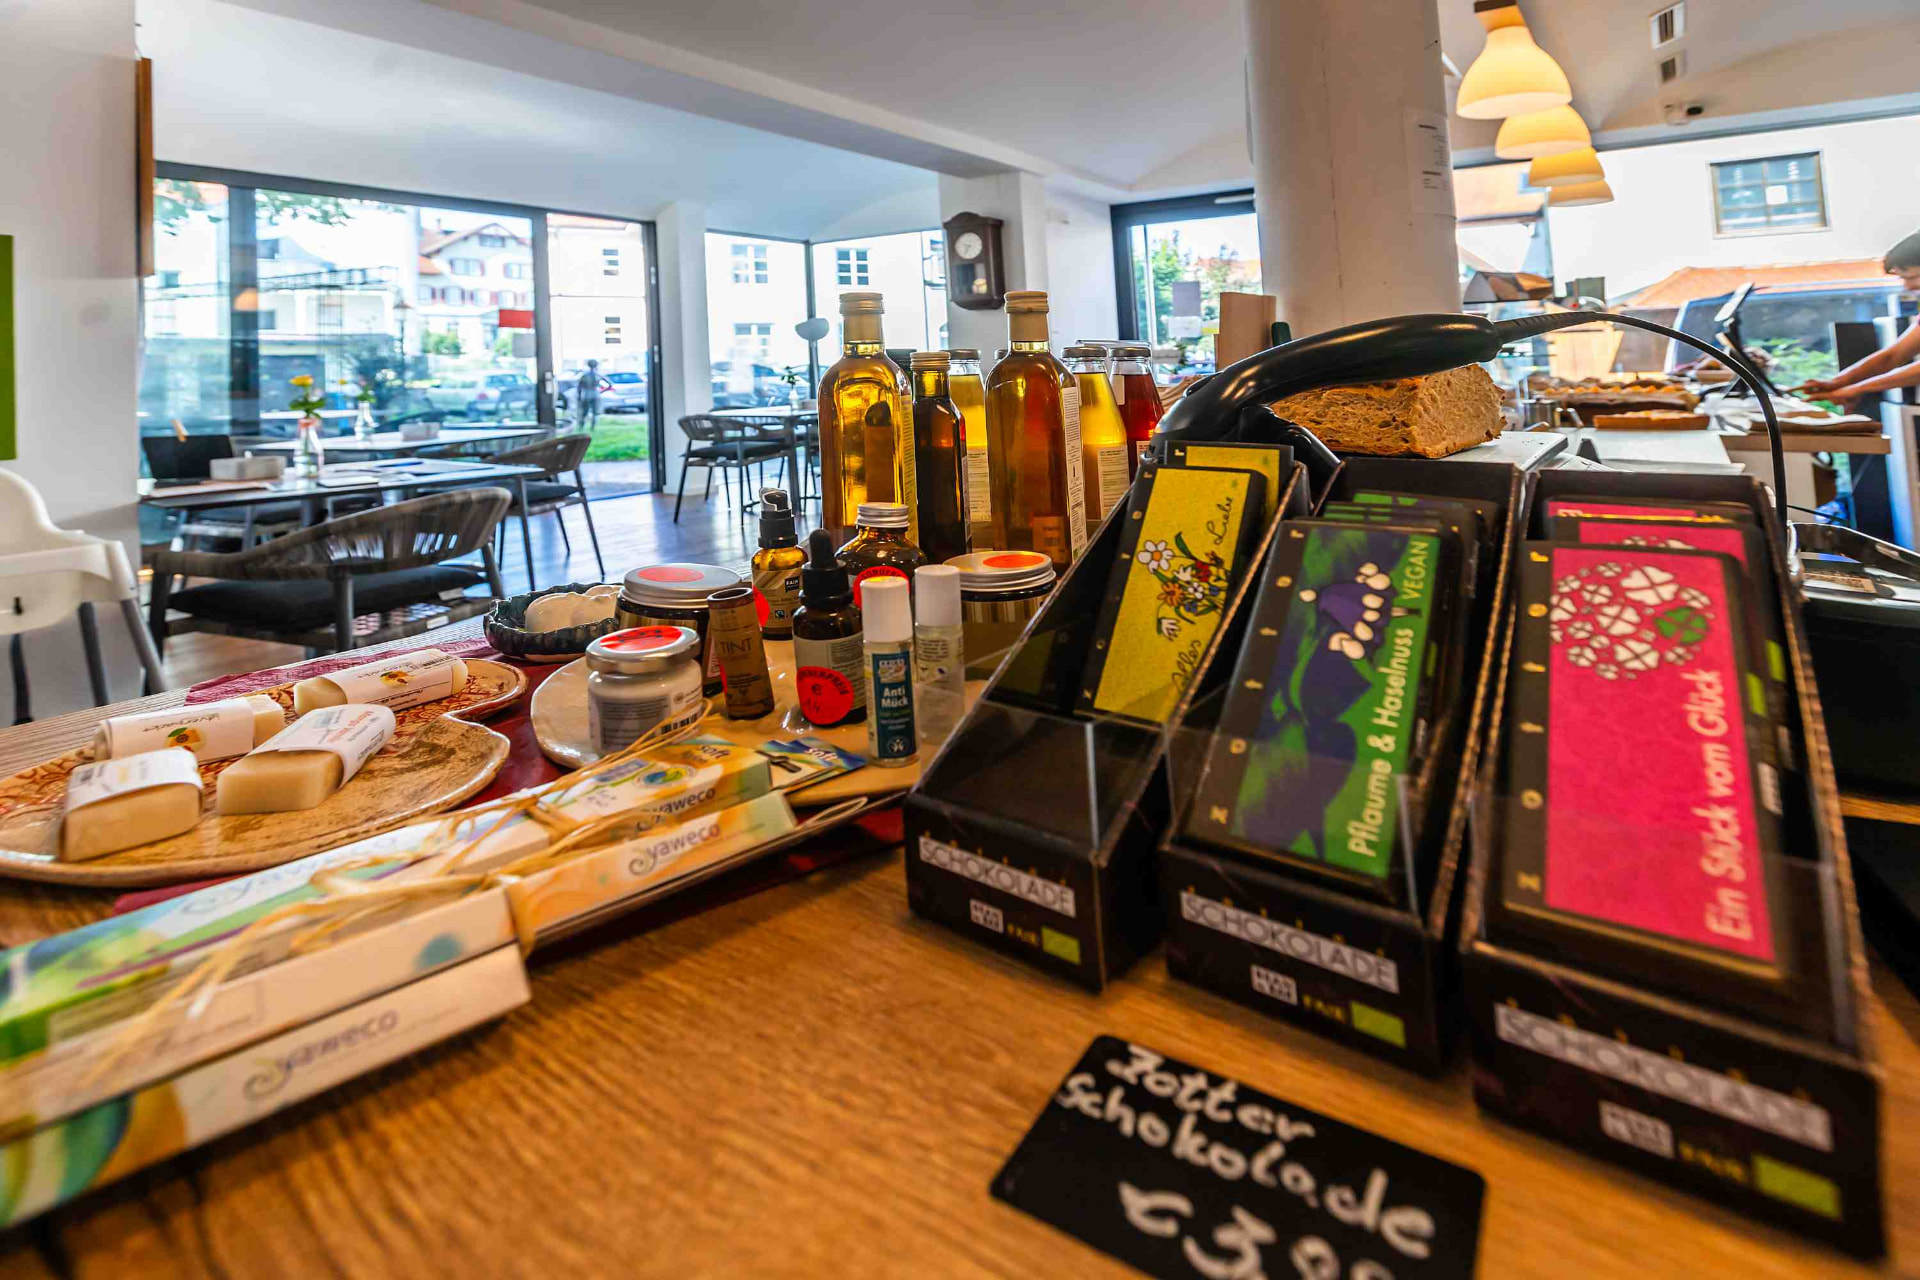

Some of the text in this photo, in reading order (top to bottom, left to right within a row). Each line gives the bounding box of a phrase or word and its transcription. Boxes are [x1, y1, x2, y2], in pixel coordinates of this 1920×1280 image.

[1206, 496, 1233, 546] Liebe
[720, 637, 752, 655] TINT
[881, 697, 908, 708] Mück
[883, 685, 906, 697] Anti
[1348, 540, 1430, 857] Pflaume & Haselnuss VEGAN
[701, 743, 731, 760] soft
[803, 746, 839, 762] soft
[1681, 668, 1754, 941] Ein Stück vom Glück
[628, 822, 720, 877] yaweco
[920, 837, 1075, 916] SCHOKOLADE
[1182, 892, 1398, 992] SCHOKOLADE
[243, 1009, 399, 1101] yaweco
[1105, 1043, 1316, 1141] Zotter
[1056, 1071, 1435, 1259] Schokolade
